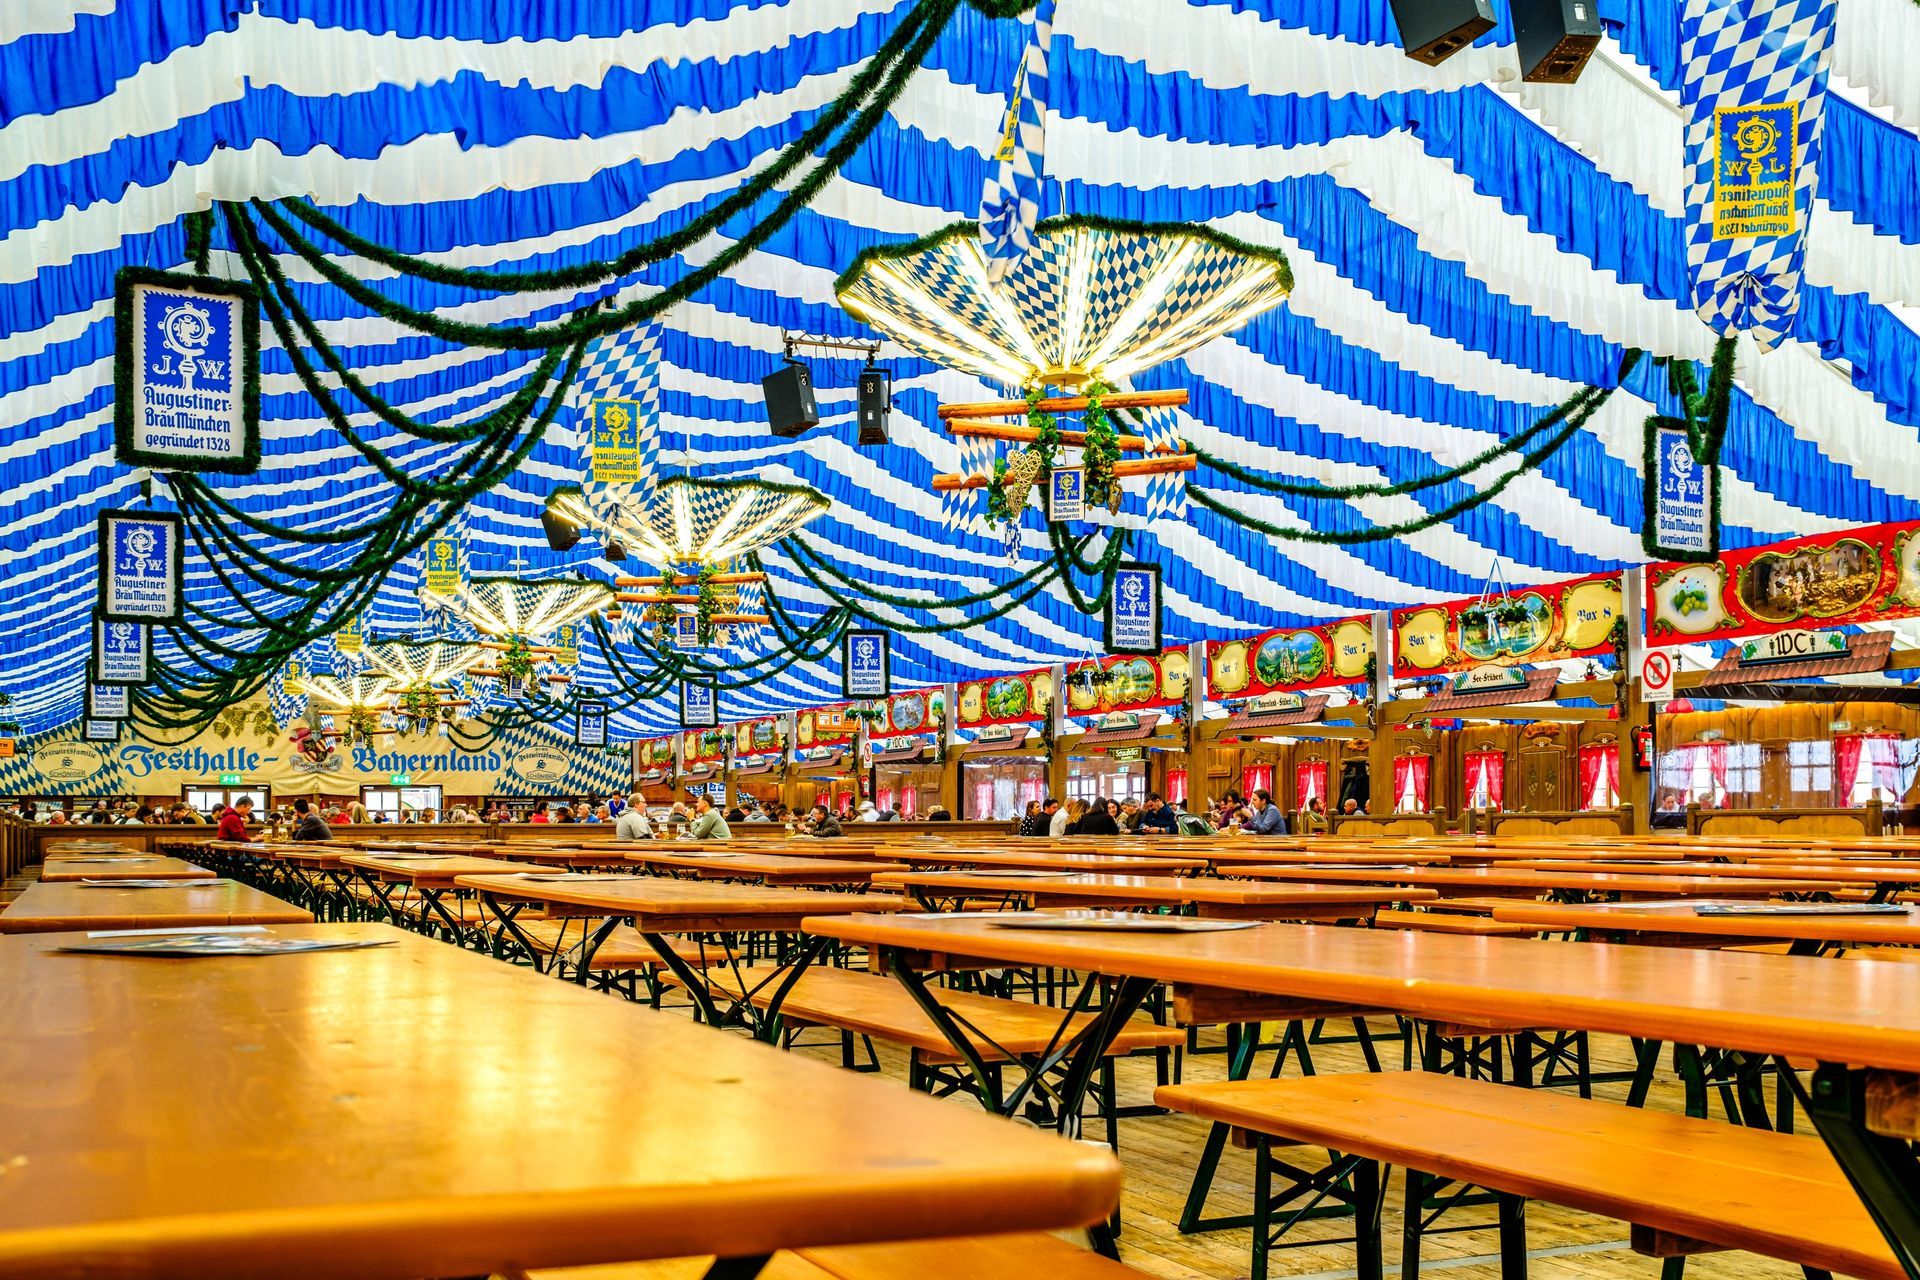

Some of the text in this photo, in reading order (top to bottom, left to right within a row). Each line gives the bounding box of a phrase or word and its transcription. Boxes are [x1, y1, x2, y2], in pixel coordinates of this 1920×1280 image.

[152, 355, 226, 381] J. W.
[145, 407, 231, 434] Bräu München
[145, 432, 231, 453] gegründet 1328
[1676, 518, 1703, 533] München
[1660, 534, 1703, 547] gegründet 1328
[115, 603, 167, 613] gegründet 1328
[1576, 609, 1598, 623] Box
[120, 744, 279, 777] Festhalle-
[352, 748, 501, 775] Bayernland
